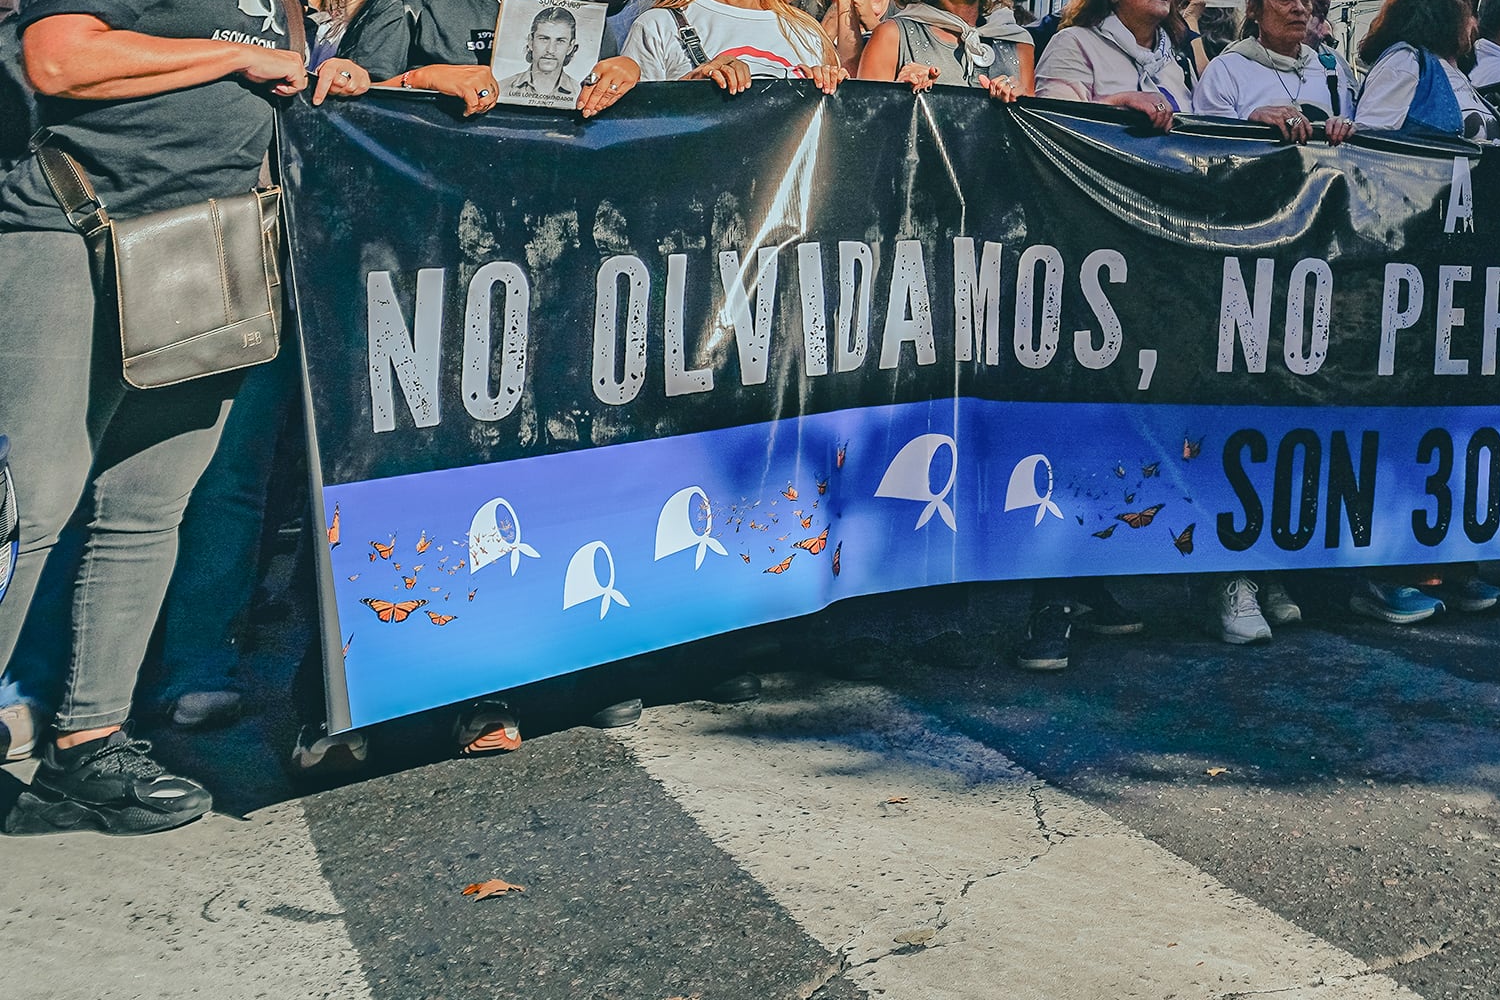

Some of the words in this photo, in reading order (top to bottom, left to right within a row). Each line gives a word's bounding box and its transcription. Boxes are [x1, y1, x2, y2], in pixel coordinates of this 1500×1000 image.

[466, 41, 486, 51] 50
[1443, 156, 1475, 234] A
[367, 260, 530, 434] NO
[591, 236, 1158, 406] OLVIDAMOS,
[1216, 256, 1333, 376] NO
[1216, 427, 1380, 552] SON
